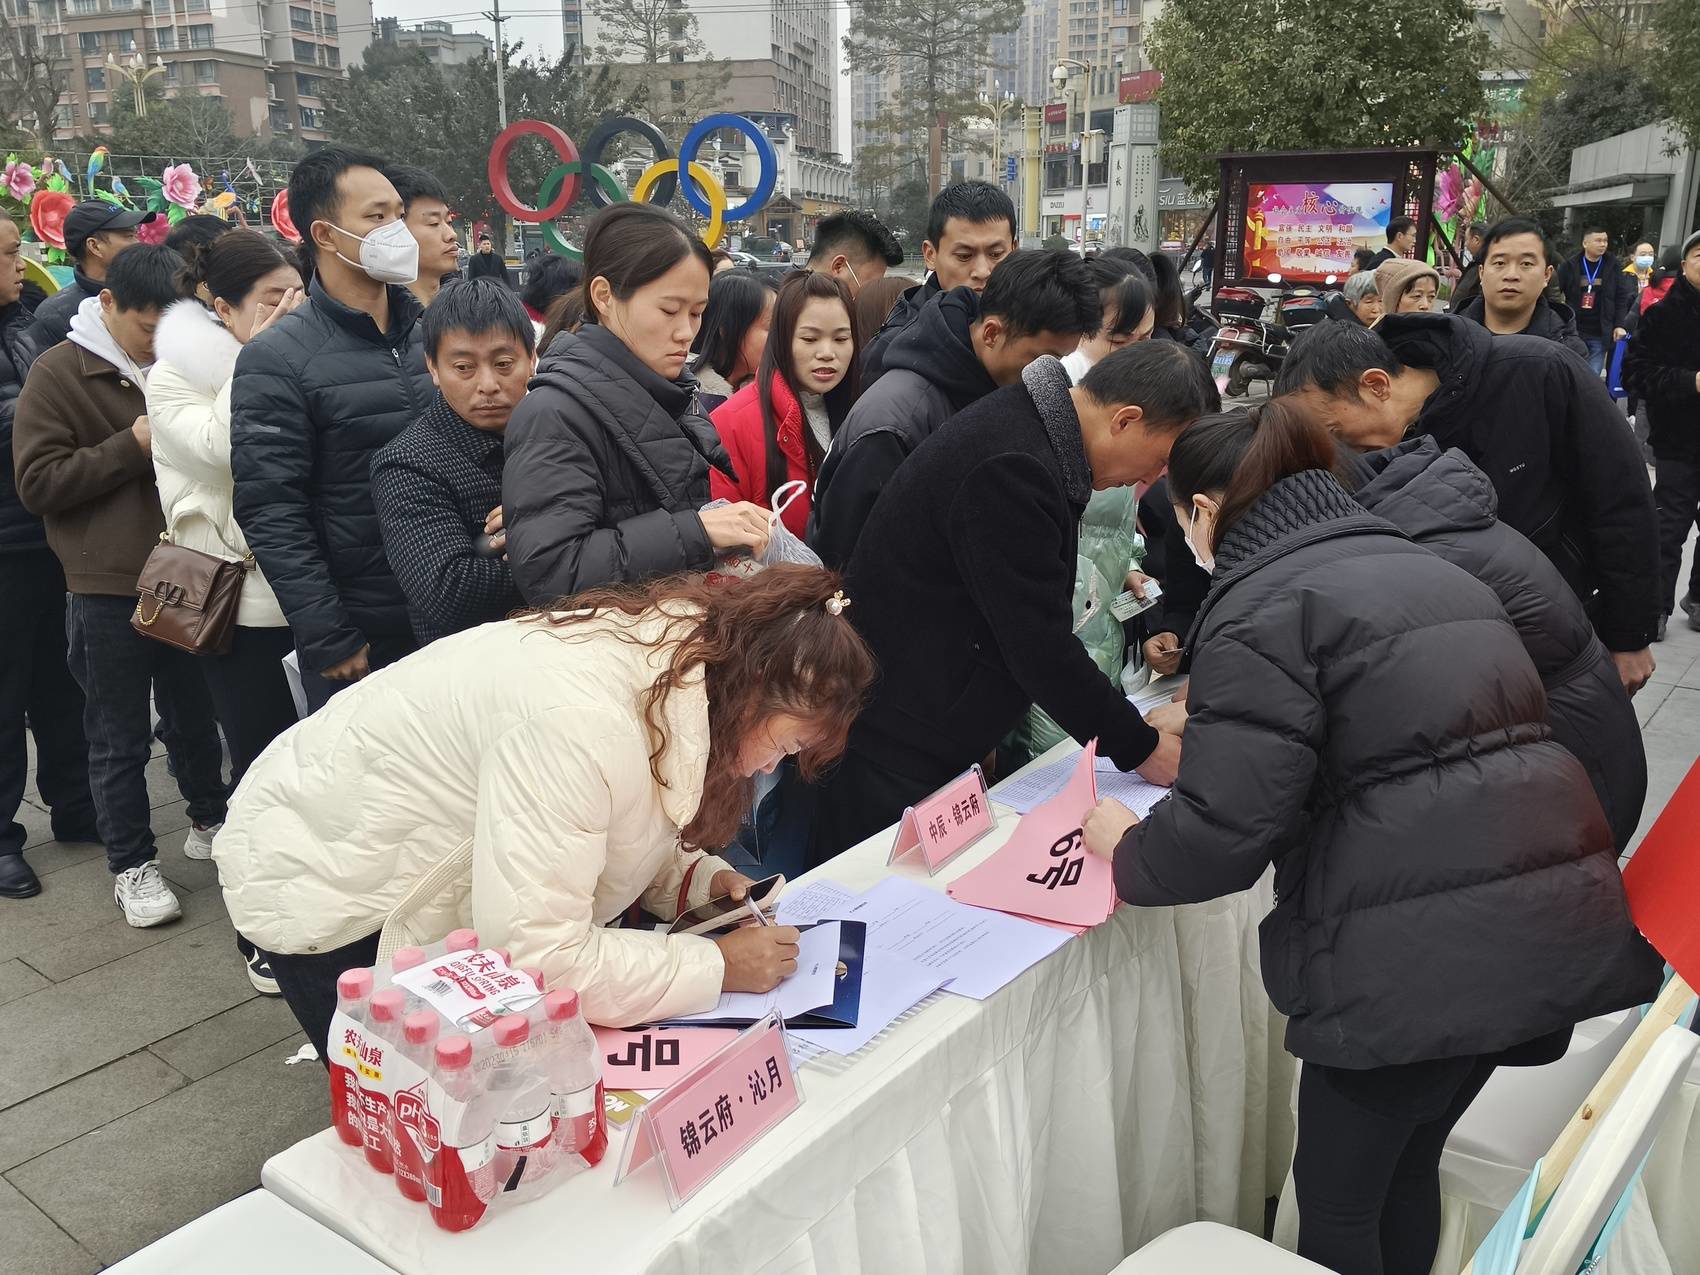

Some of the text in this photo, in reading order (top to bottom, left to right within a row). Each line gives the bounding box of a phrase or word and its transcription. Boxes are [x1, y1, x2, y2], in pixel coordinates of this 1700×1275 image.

[928, 793, 981, 844] 中辰·锦云府
[1026, 828, 1084, 890] 6号
[607, 1027, 680, 1071] 号
[680, 1056, 783, 1159] 锦云府·沁月
